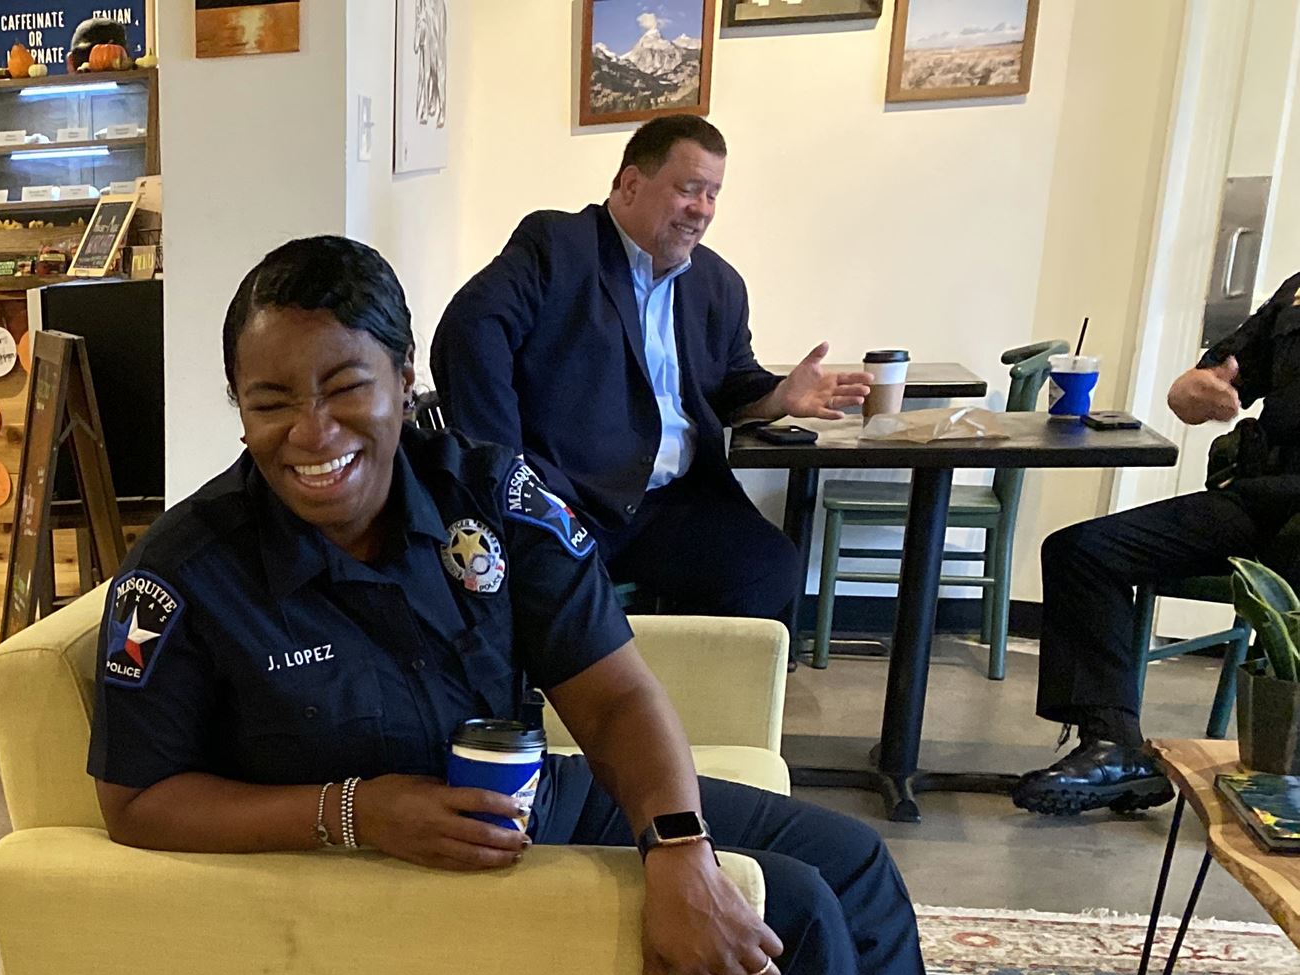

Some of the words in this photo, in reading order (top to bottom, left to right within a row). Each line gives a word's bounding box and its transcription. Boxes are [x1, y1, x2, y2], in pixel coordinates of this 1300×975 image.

[0, 11, 64, 32] CAFFEINATE
[28, 31, 43, 47] OR
[116, 577, 178, 613] MESQUITE
[267, 655, 281, 672] J.
[284, 643, 335, 667] LOPEZ
